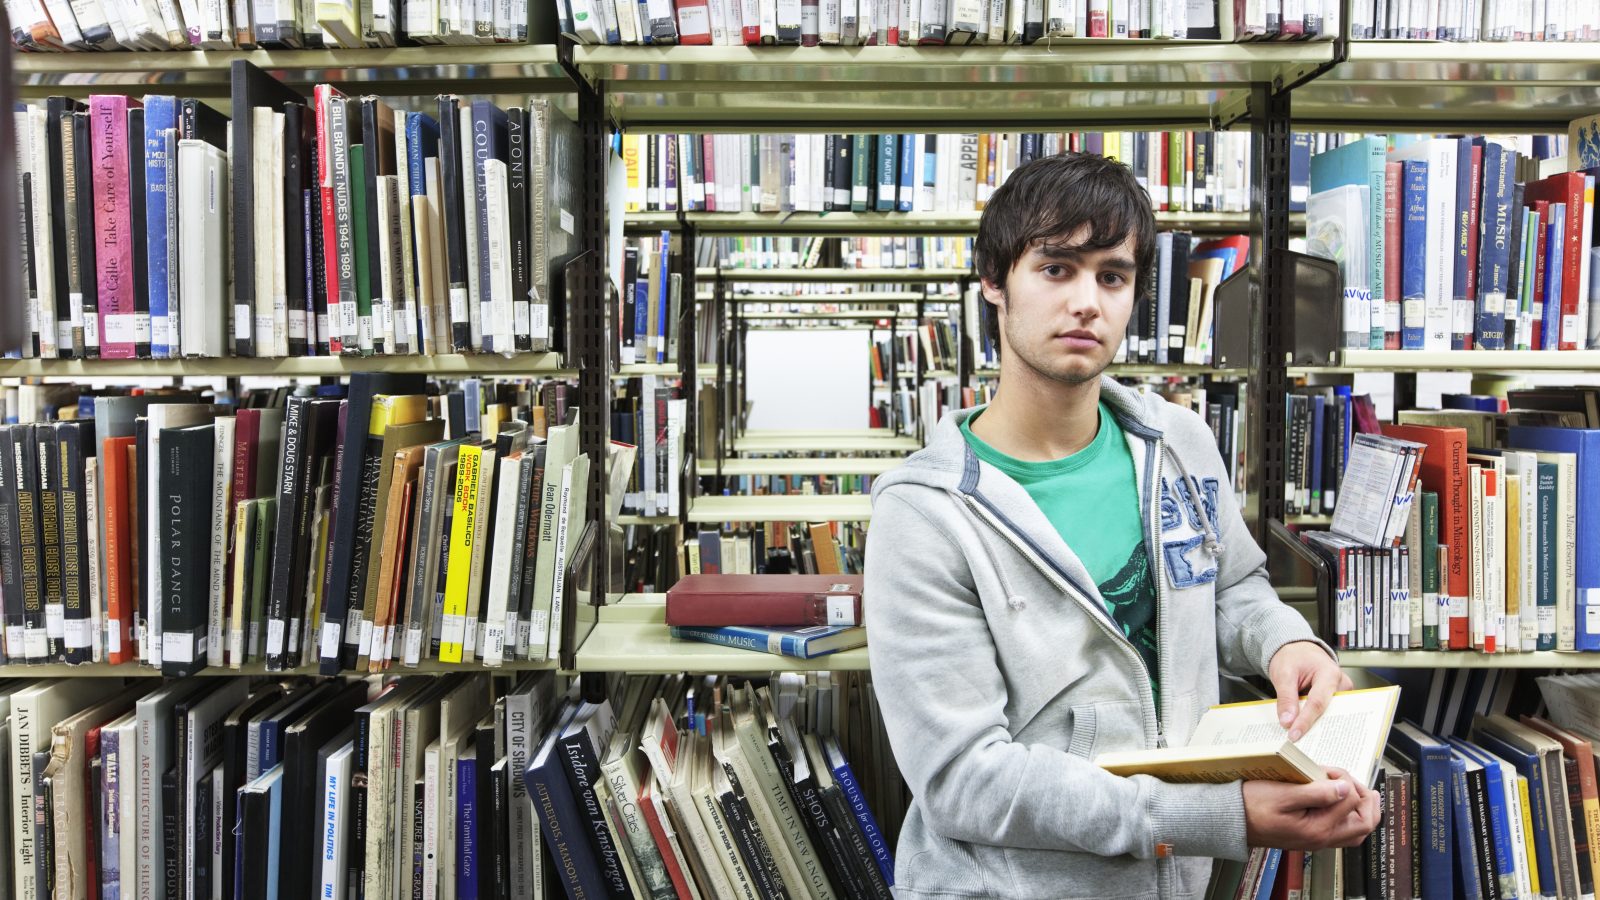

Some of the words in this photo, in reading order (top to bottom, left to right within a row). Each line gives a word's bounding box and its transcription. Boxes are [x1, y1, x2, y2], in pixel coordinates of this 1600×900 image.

[99, 104, 113, 162] Yourself
[331, 106, 343, 130] BILL
[333, 131, 344, 180] BRANDT:
[510, 121, 523, 189] ADONIS
[884, 146, 893, 156] OF
[1196, 144, 1206, 181] RUBENS
[101, 164, 115, 179] of
[103, 184, 116, 213] Care
[336, 182, 348, 221] NUDES
[1414, 195, 1422, 204] by
[104, 217, 117, 248] Take
[1460, 228, 1468, 248] MUSIC
[1495, 202, 1507, 250] MUSIC
[338, 223, 351, 279] 1945-1980
[1375, 239, 1383, 267] MUSIC
[105, 257, 119, 291] Calle
[1375, 269, 1383, 281] and
[1493, 263, 1501, 287] James
[288, 403, 299, 427] MIKE
[287, 428, 297, 436] &
[14, 442, 23, 489] MISSINGHAM
[39, 442, 47, 489] MISSINGHAM
[235, 441, 247, 486] MASTER
[285, 437, 297, 464] DOUG
[1452, 441, 1463, 476] Current
[283, 464, 295, 494] STARN
[371, 456, 382, 483] MAX
[456, 454, 466, 503] 1969-2006
[464, 454, 473, 482] WORK
[468, 454, 479, 500] GABRIELE
[357, 454, 373, 532] AUSTRALIAN
[461, 485, 470, 512] BOOK
[531, 467, 544, 506] Picture
[546, 482, 558, 502] Jean
[561, 487, 570, 514] Raymond
[1450, 478, 1462, 514] Thought
[17, 491, 33, 545] AUSTRALIA
[42, 491, 58, 545] AUSTRALIA
[62, 491, 77, 544] AUSTRALIA
[169, 494, 182, 549] POLAR
[214, 480, 223, 531] MOUNTAINS
[364, 488, 379, 543] DUPAIN'S
[517, 504, 526, 523] EVERY
[561, 517, 568, 525] de
[1453, 515, 1462, 525] in
[255, 518, 263, 551] GROTESQUE
[464, 503, 474, 547] BASILICO
[515, 524, 524, 540] TURN
[526, 508, 541, 559] Windows
[542, 503, 556, 542] Odermatt
[1566, 513, 1575, 539] Music
[214, 534, 222, 545] OF
[1451, 526, 1463, 576] Musicology
[21, 547, 36, 577] CLOSE
[45, 547, 60, 577] CLOSE
[65, 545, 79, 575] CLOSE
[213, 549, 221, 565] THE
[1565, 540, 1575, 578] Research
[171, 557, 181, 614] DANCE
[212, 568, 221, 591] MIND
[416, 567, 424, 586] ADAMS
[555, 557, 565, 593] AUSTRALIAN
[24, 579, 39, 611] FOCUS
[66, 576, 80, 609] FOCUS
[727, 635, 756, 649] MUSIC
[17, 707, 29, 730] JAN
[511, 711, 525, 733] CITY
[512, 736, 525, 748] OF
[19, 734, 31, 784] DIBBETS
[106, 753, 117, 783] WALLS
[512, 750, 526, 798] SHADOWS
[142, 754, 150, 841] ARCHITECTURE
[329, 775, 337, 790] MY
[21, 794, 32, 835] Interior
[328, 791, 336, 809] LIFE
[328, 810, 336, 821] IN
[463, 802, 472, 819] The
[610, 774, 626, 801] Silver
[621, 797, 640, 833] Cities
[701, 794, 724, 830] PICTURES
[803, 788, 829, 828] SHOTS
[1430, 785, 1438, 817] ANALYSIS
[1437, 780, 1445, 822] PHILOSOPHY
[55, 792, 66, 848] TRAGER
[414, 801, 423, 841] NATURE
[536, 782, 561, 845] AUTREFOIS,
[557, 841, 576, 883] MAISON
[565, 742, 589, 792] Isidore
[582, 788, 599, 816] van
[593, 817, 625, 892] Kinsbergen
[771, 784, 789, 815] TIME
[784, 814, 795, 830] IN
[792, 831, 810, 857] NEW
[840, 771, 863, 812] BOUND
[857, 808, 868, 823] for
[865, 823, 889, 862] GLORY
[1431, 817, 1438, 827] OF
[1478, 803, 1487, 837] IMAGINARY
[1491, 805, 1502, 847] BEAUTIFUL
[1555, 804, 1567, 860] Understanding
[165, 815, 176, 851] FIFTY
[326, 822, 335, 860] POLITICS
[463, 820, 472, 854] Familial
[717, 829, 733, 850] FROM
[738, 827, 758, 857] PORTRAITS
[19, 838, 32, 865] Light
[142, 845, 150, 860] OF
[463, 855, 471, 877] Gaze
[727, 849, 740, 866] THE
[751, 855, 764, 870] FROM
[1482, 837, 1491, 863] MUSEUM
[733, 864, 748, 883] NEW
[757, 869, 772, 889] NORTH
[1486, 871, 1494, 896] MUSICAL
[325, 883, 333, 899] TIM
